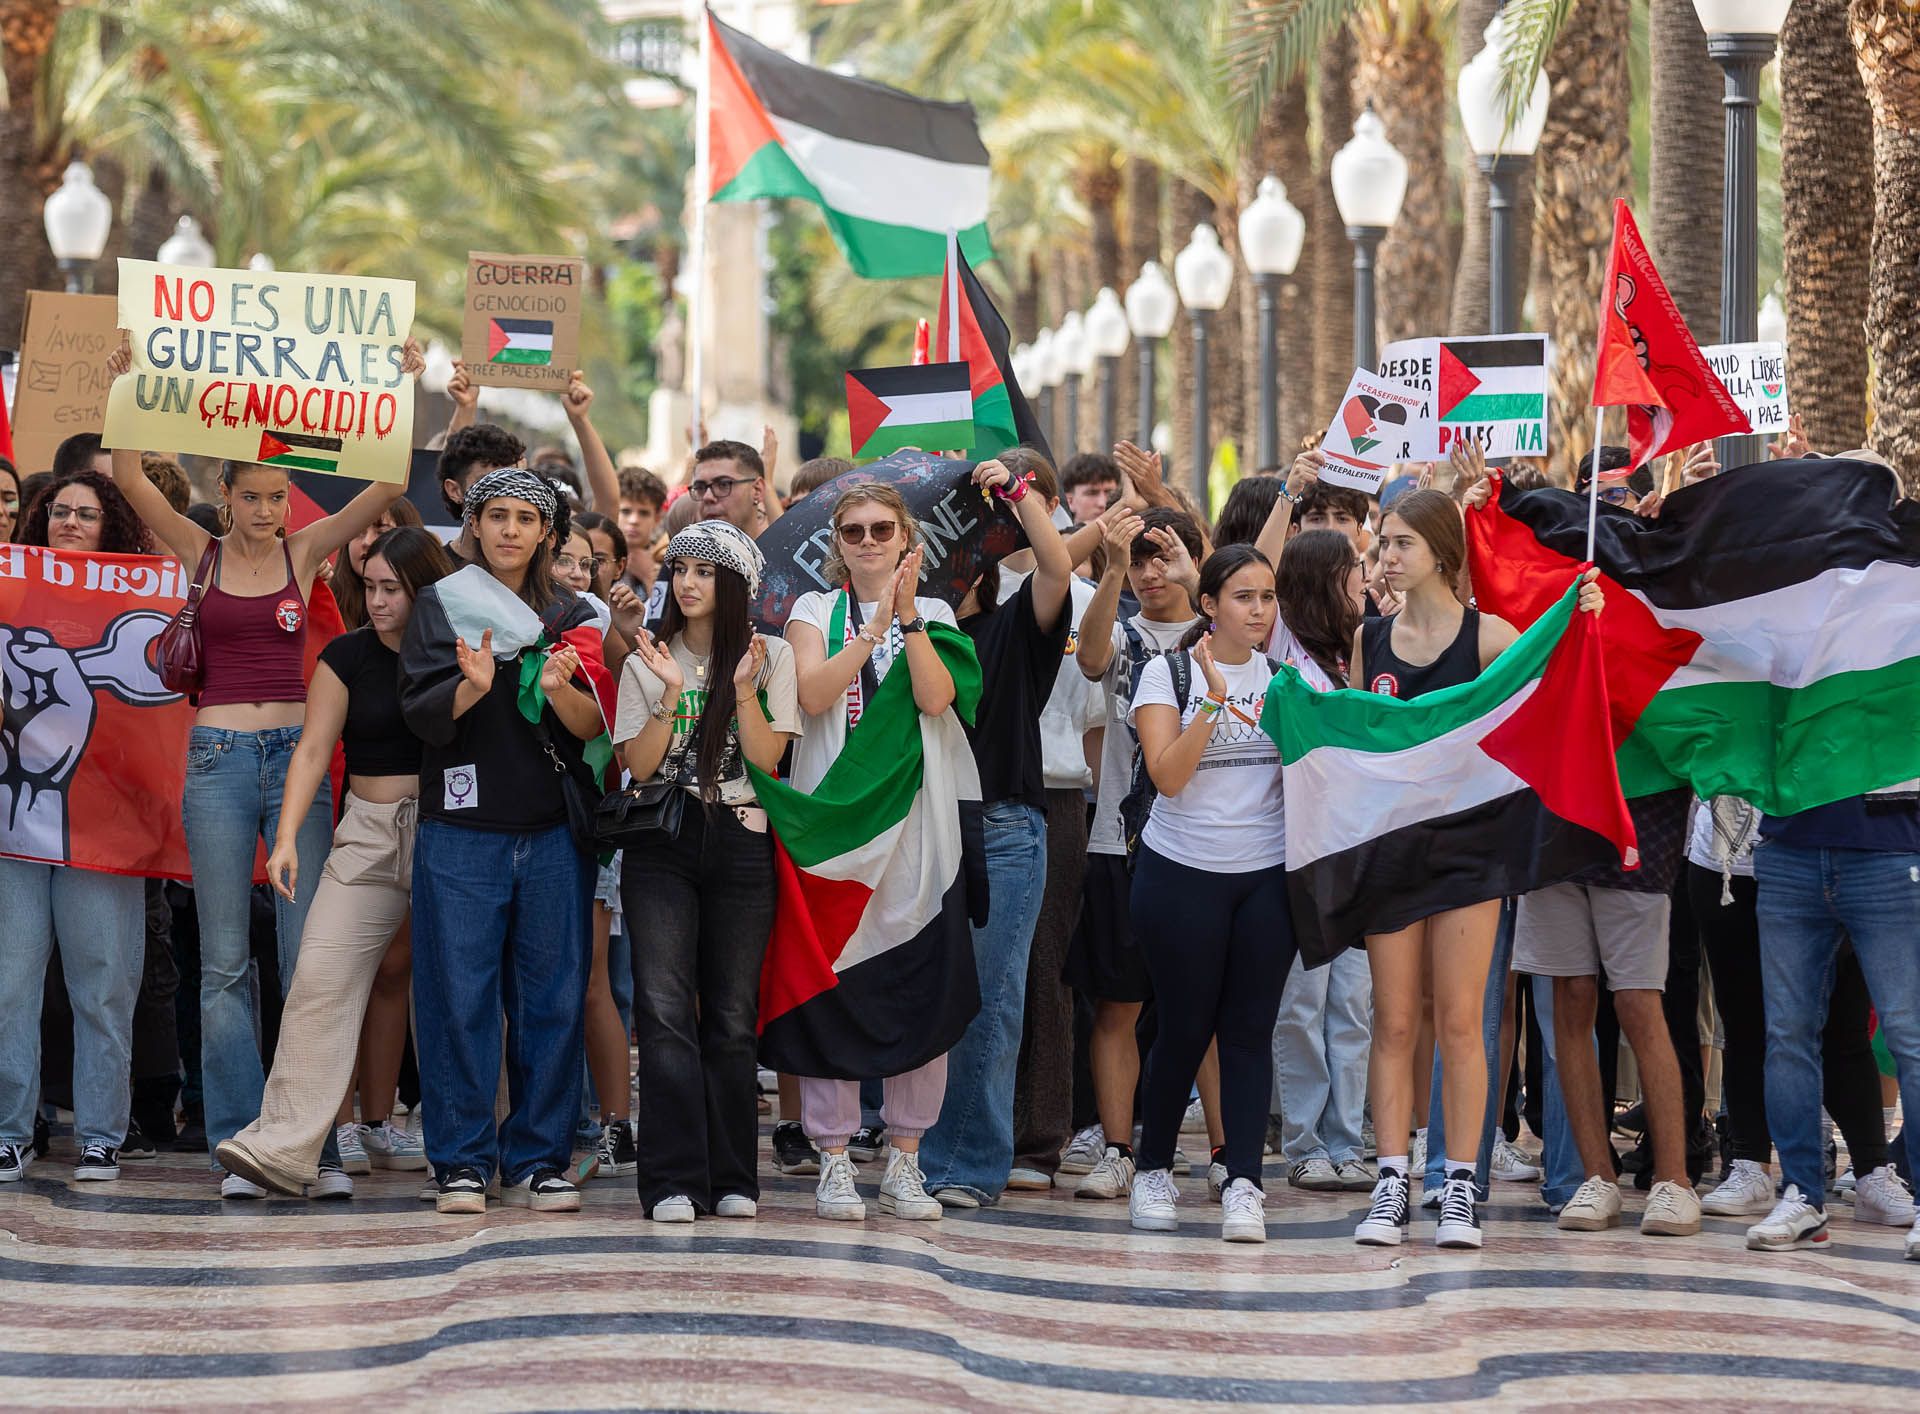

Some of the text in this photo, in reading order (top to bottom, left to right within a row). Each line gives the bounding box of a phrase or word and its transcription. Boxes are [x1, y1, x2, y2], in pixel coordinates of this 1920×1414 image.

[476, 263, 573, 286] GUERRA
[154, 275, 397, 336] NO ES UNA
[1380, 358, 1432, 378] DESDE
[1706, 354, 1740, 375] MUD
[1356, 381, 1421, 408] #CEASEFIRENOW
[136, 374, 397, 440] UN GENOCIDIO
[1758, 404, 1784, 425] PAZ
